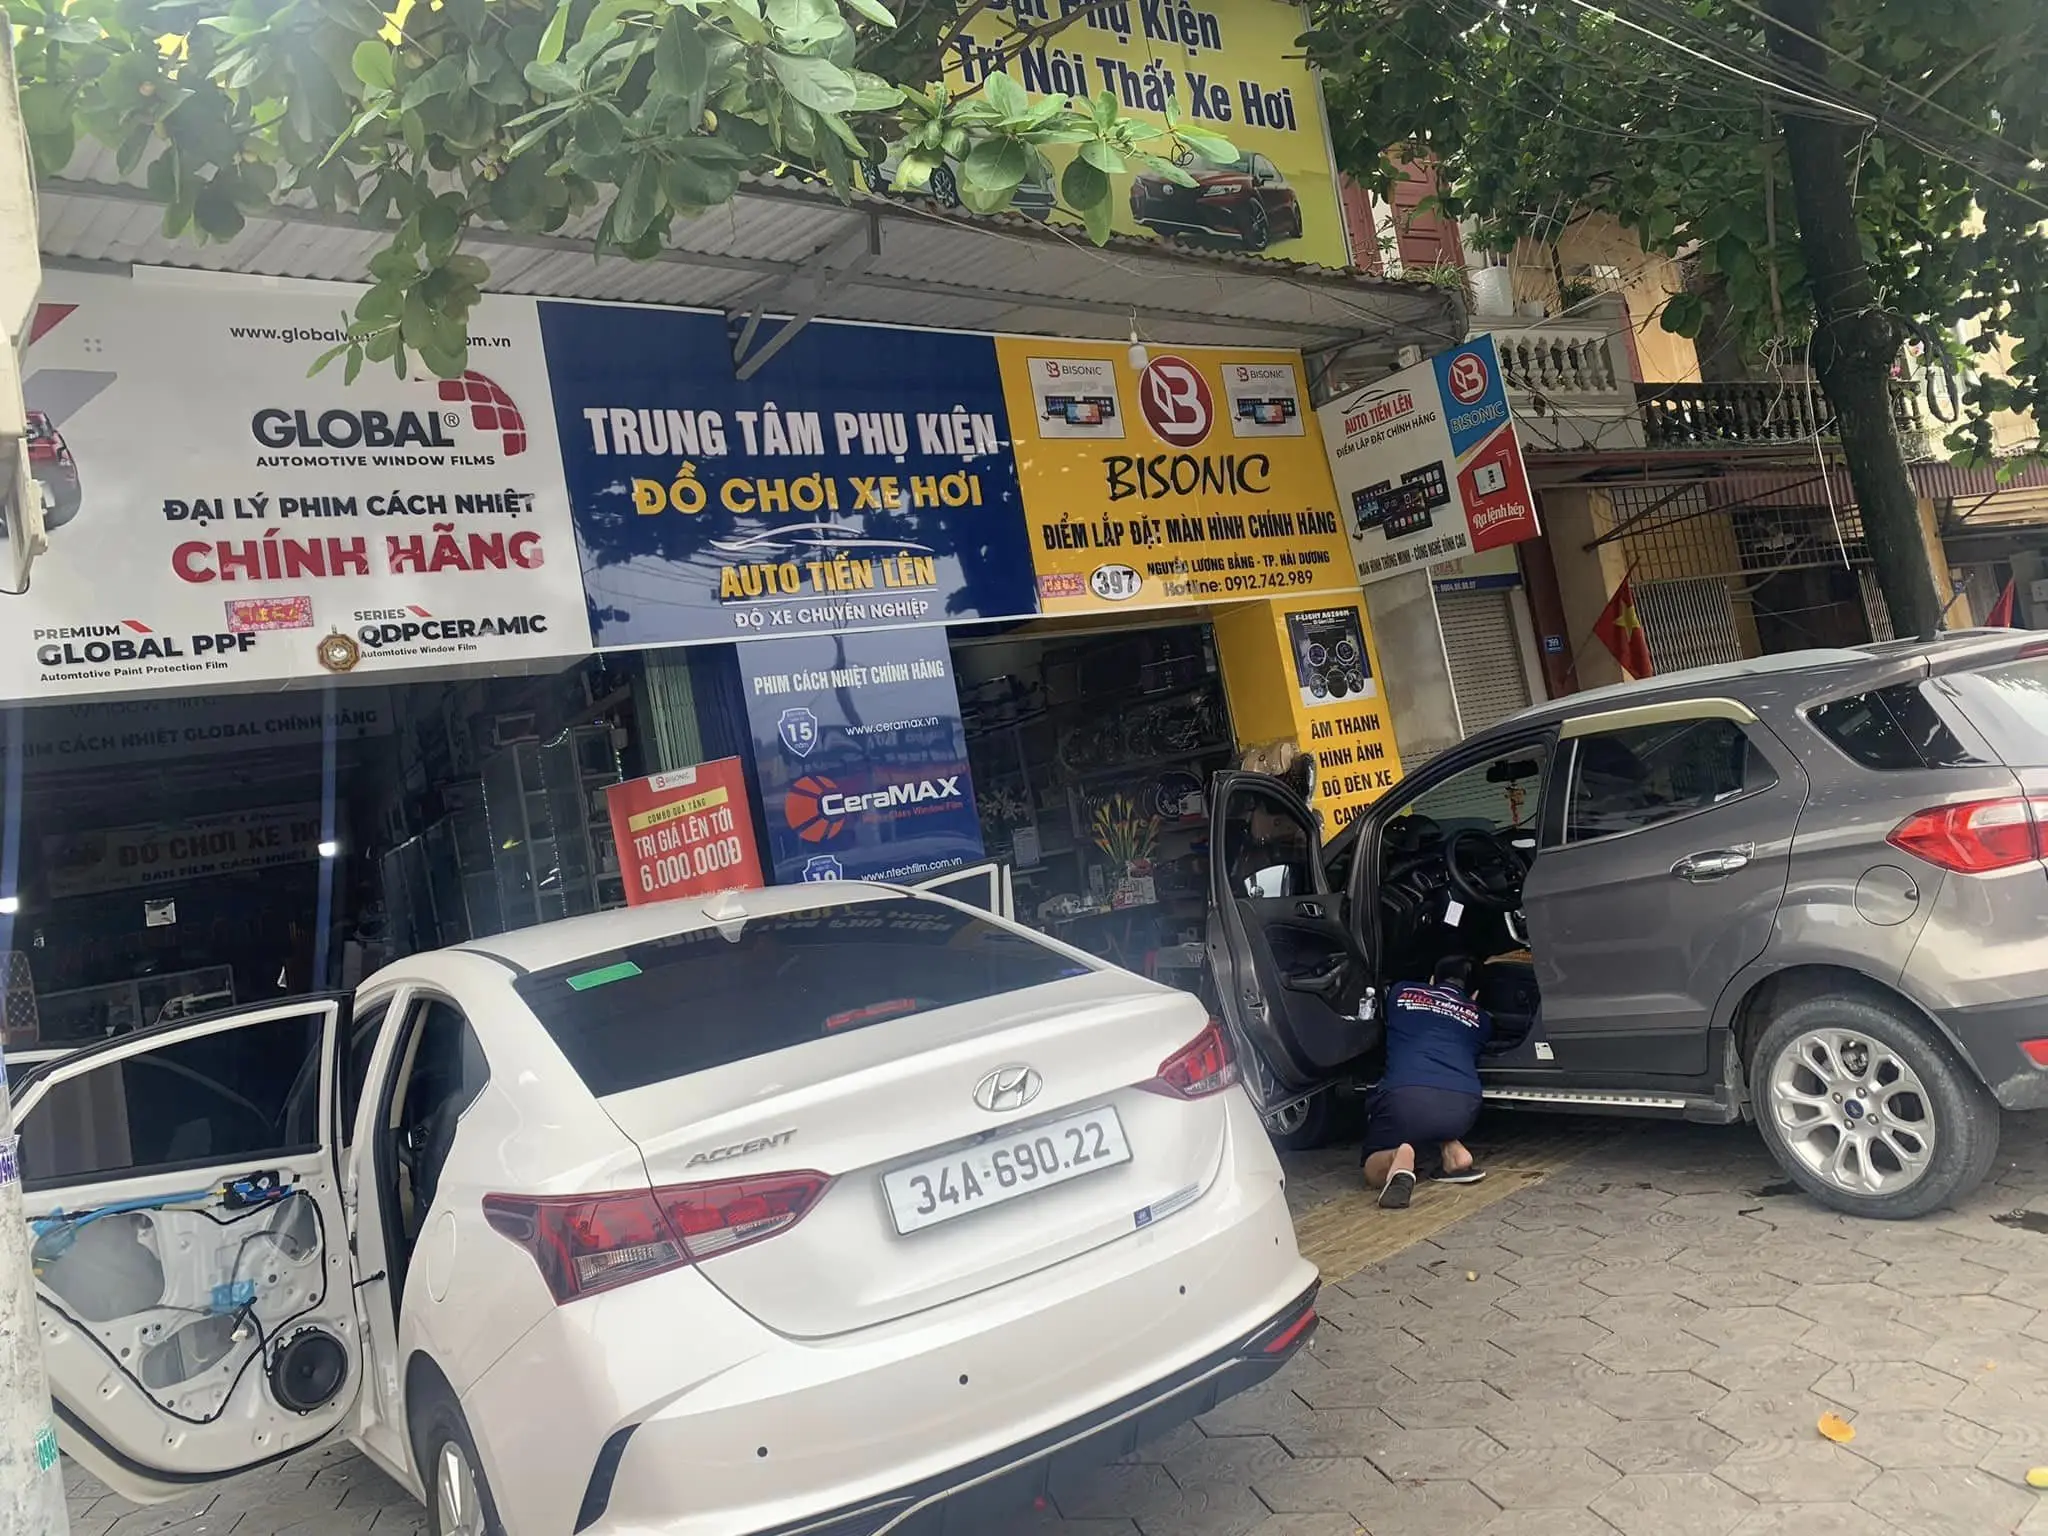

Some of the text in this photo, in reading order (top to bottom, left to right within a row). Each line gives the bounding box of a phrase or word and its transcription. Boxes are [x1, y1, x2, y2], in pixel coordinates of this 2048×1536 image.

[1020, 48, 1088, 109] Nội
[1096, 58, 1176, 112] Thất
[1186, 72, 1231, 122] Xe
[1238, 81, 1297, 132] Hơi
[1062, 364, 1102, 376] BISONIC
[1250, 369, 1284, 380] BISONIC
[1344, 393, 1413, 434] AUTO TIẾN LÊN
[1452, 400, 1506, 434] BISONIC
[583, 401, 999, 463] TRUNG TÂM PHỤ KIỆN
[1336, 411, 1437, 458] ĐIỂM LẮP ĐẶT CHÍNH HÃNG
[256, 454, 496, 467] AUTOMOTIVE WINDOW FILMS
[632, 460, 983, 516] ĐỒ CHƠI XE HƠI
[1103, 453, 1272, 502] BISONIC
[162, 487, 536, 527] ĐẠI LÝ PHIM CÁCH NHIỆT
[1473, 502, 1526, 529] Ra lệnh kép
[1042, 506, 1338, 551] ĐIỂM LẮP ĐẶT MÀN HÌNH CHÍNH HÃNG
[172, 522, 545, 584] CHÍNH HÃNG
[1191, 555, 1226, 573] LƯƠNG
[1262, 553, 1278, 568] TP.
[1298, 550, 1330, 565] DƯƠNG
[721, 551, 937, 600] AUTO TIẾN LÊN
[1095, 569, 1137, 597] 397
[1163, 570, 1314, 598] Hotline: 0912.742.989
[353, 608, 406, 622] SERIES
[357, 614, 548, 647] QDPCERAMIC
[735, 599, 929, 632] ĐỘ XE CHUYÊN NGHIỆP
[33, 623, 121, 641] PREMIUM
[36, 631, 257, 667] GLOBAL PPF
[360, 641, 478, 659] Automtotive Window Film
[40, 658, 229, 682] Automtotive Paint Protection Film
[754, 657, 945, 695] PHIM CÁCH NHIỆT CHÍNH HÃNG
[58, 731, 116, 754] CÁCH
[183, 721, 261, 744] GLOBAL
[265, 710, 322, 734] CHÍNH
[787, 722, 813, 742] 15
[845, 715, 940, 736] www.ceramax.vn
[1311, 713, 1381, 740] ÂM THANH
[1319, 739, 1384, 768] HÌNH ẢNH
[822, 775, 962, 816] CeraMAX
[1344, 771, 1373, 794] ĐÈN
[1375, 768, 1393, 788] XE
[648, 809, 671, 824] COMBO
[1333, 801, 1374, 826] CAM
[247, 820, 281, 849] XE
[634, 806, 734, 860] TRỊ GIÁ LÊN TỚI
[640, 836, 742, 893] 6.000.000Đ
[861, 856, 962, 882] www.ntechfilm.com.vn
[686, 1128, 798, 1170] ACCENT
[909, 1121, 1111, 1216] 34A-690.22
